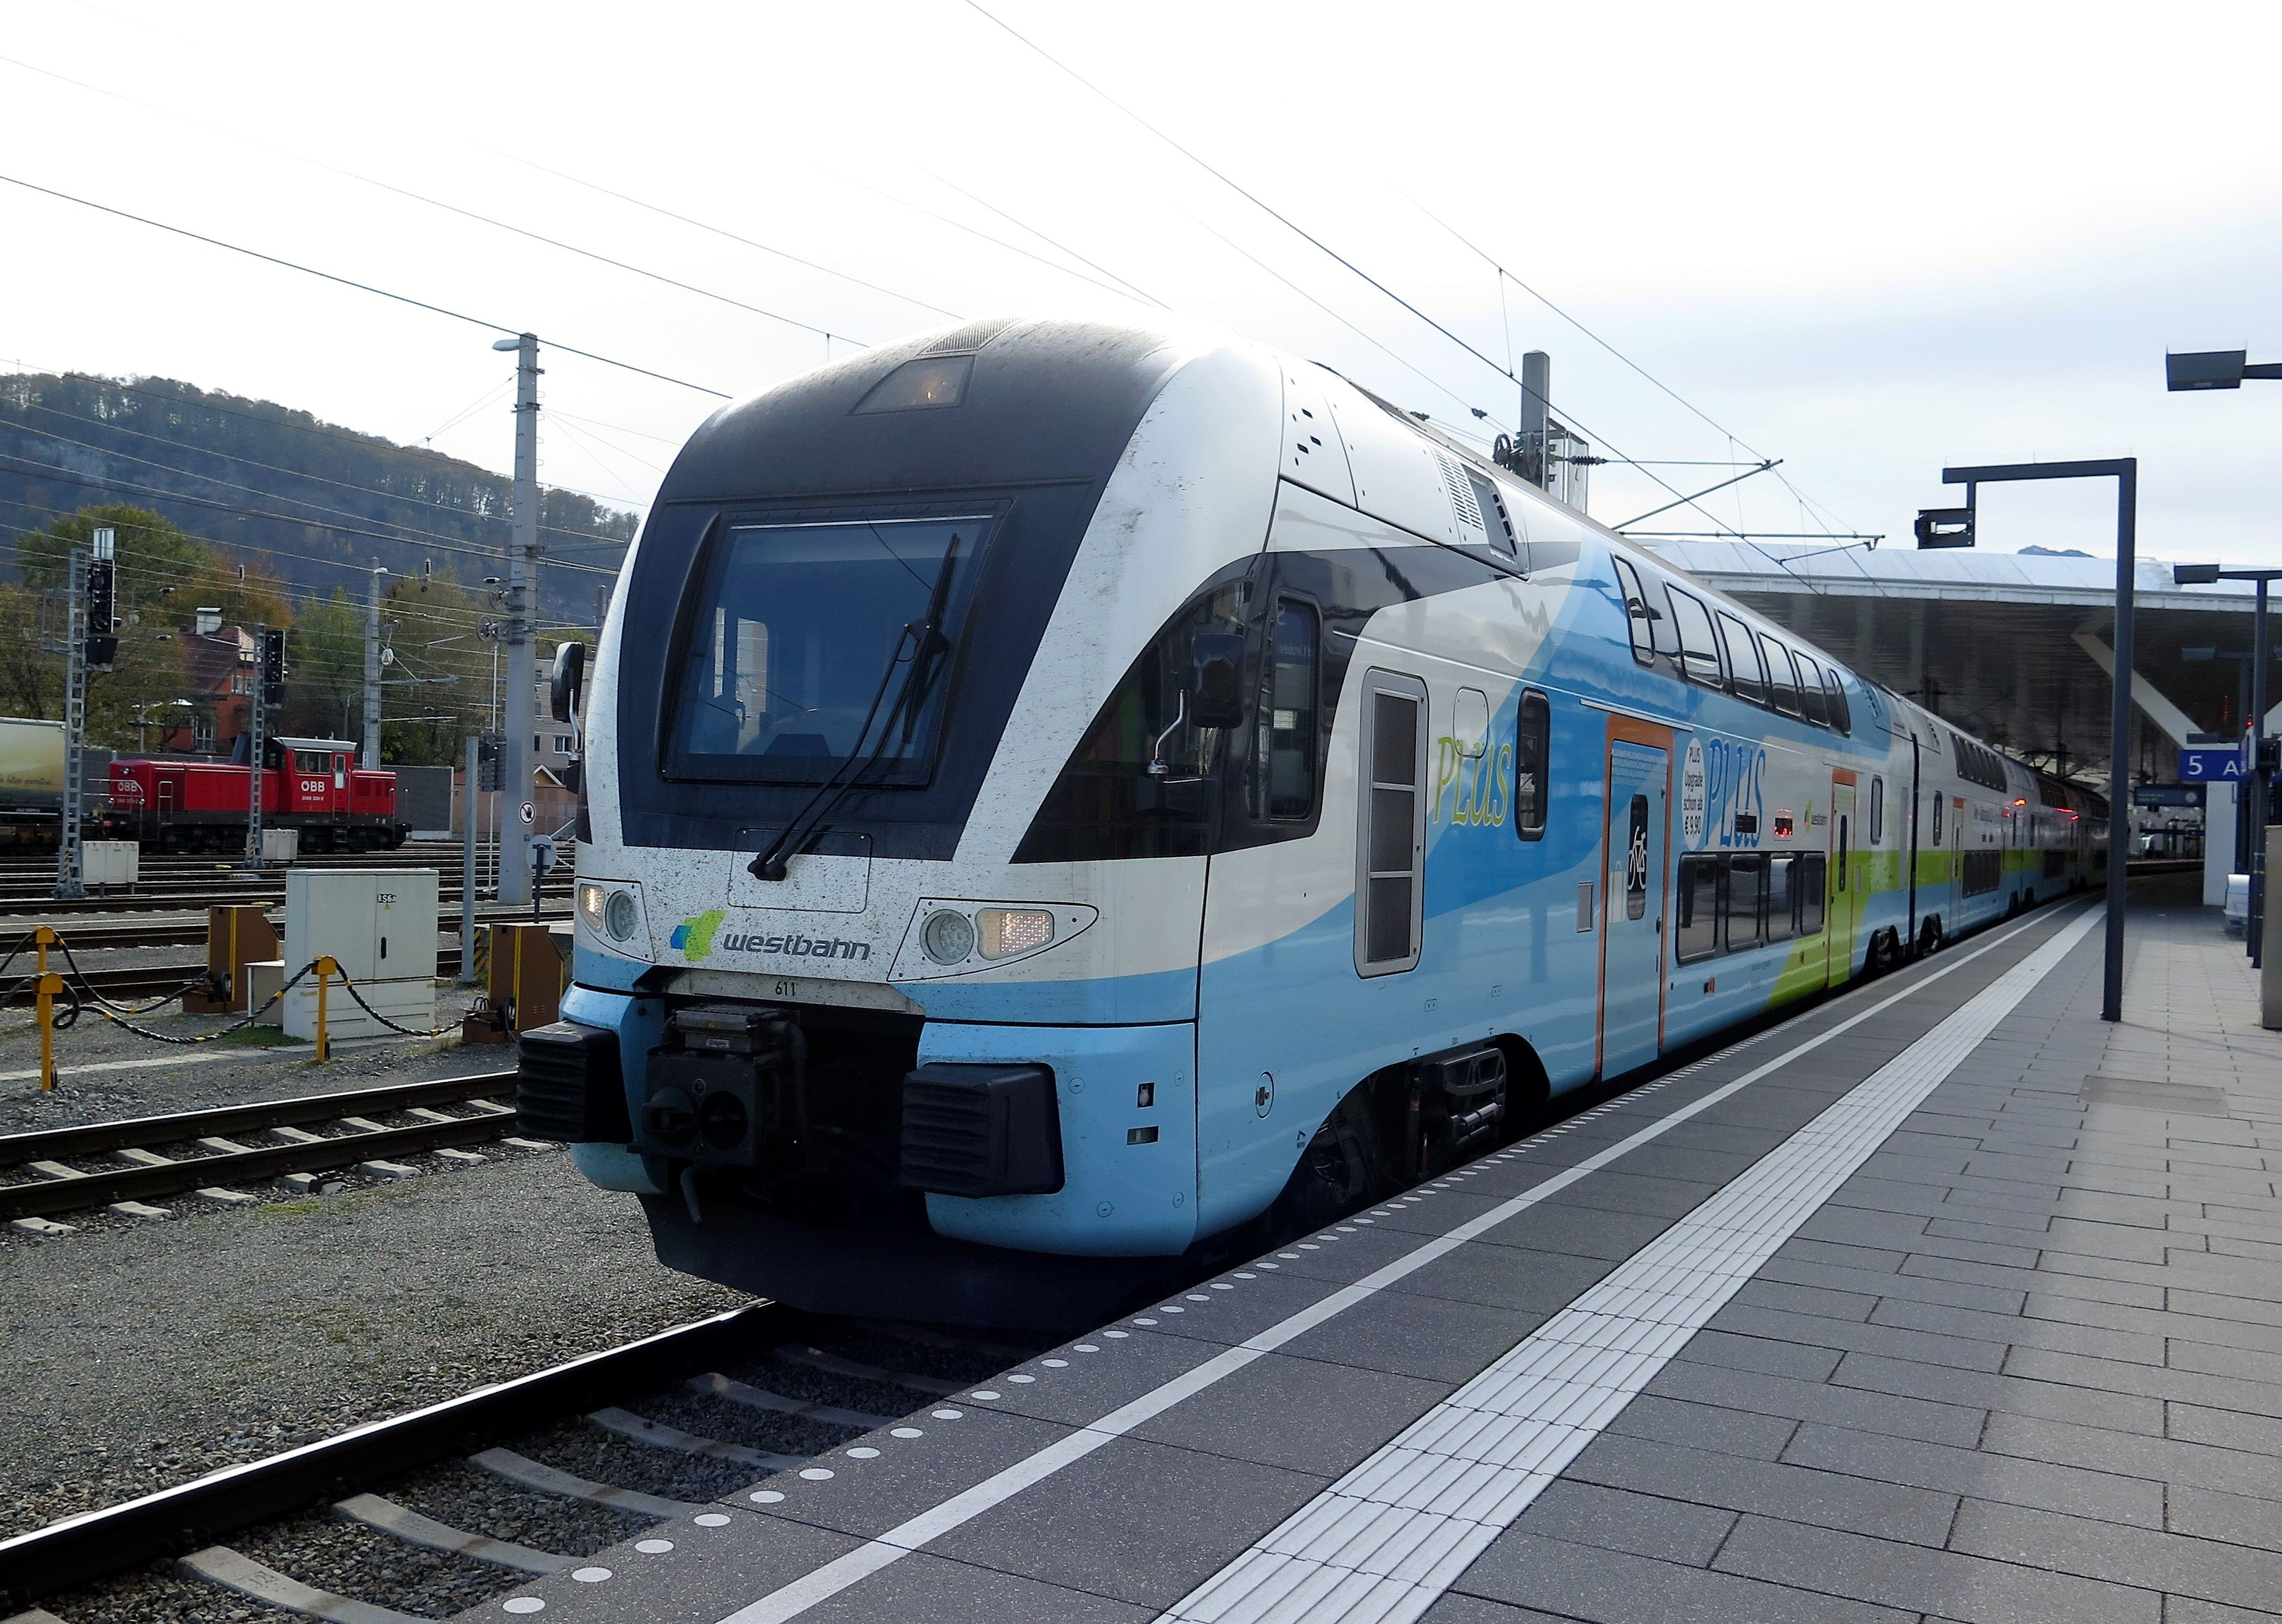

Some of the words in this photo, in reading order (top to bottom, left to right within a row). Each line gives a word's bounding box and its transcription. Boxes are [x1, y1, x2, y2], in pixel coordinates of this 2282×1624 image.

[2188, 756, 2203, 776] 5
[2223, 760, 2240, 776] A
[723, 933, 872, 960] westbahn
[775, 981, 796, 997] 611
